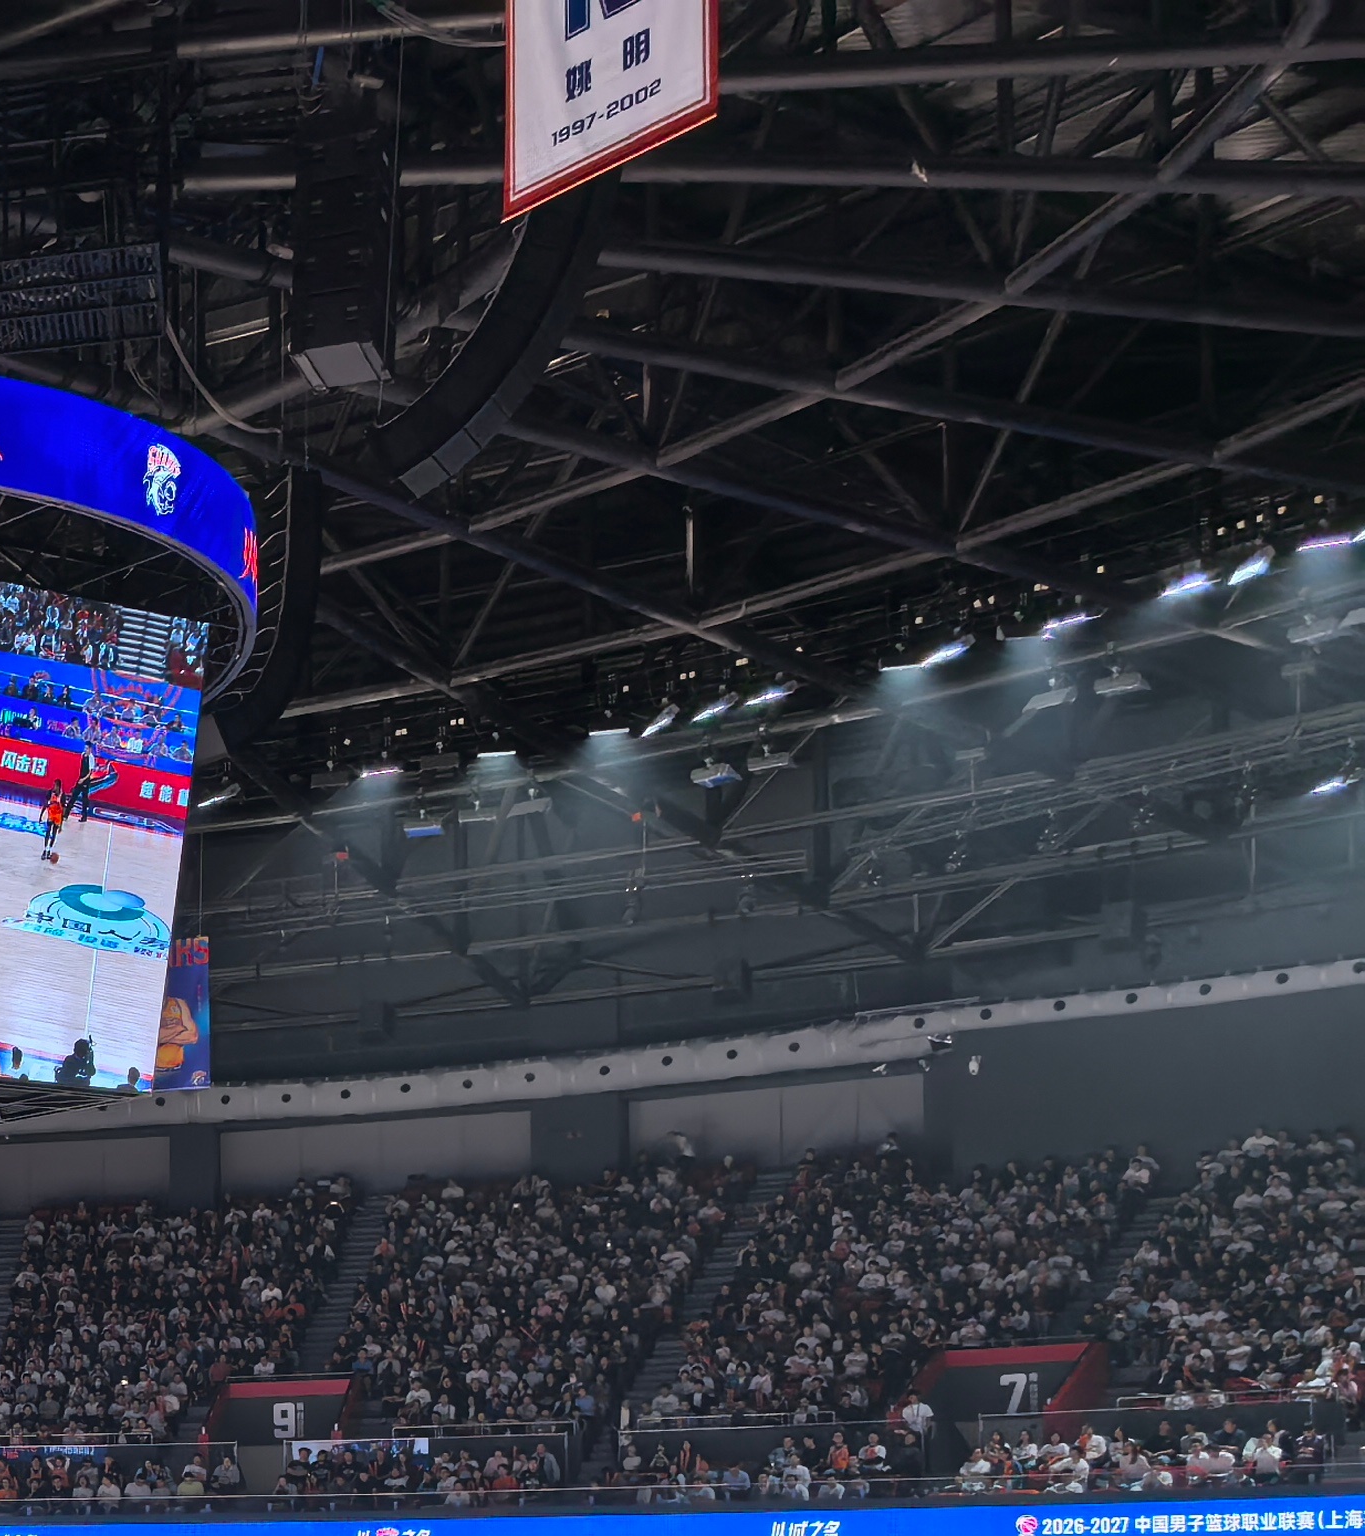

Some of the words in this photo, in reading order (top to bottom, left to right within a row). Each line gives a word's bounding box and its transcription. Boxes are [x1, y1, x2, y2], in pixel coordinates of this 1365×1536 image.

[565, 28, 650, 102] 姚明
[551, 78, 662, 147] 1997-2002
[0, 749, 49, 777] 闪击13
[139, 780, 191, 808] 超能
[1000, 1373, 1027, 1414] 7
[273, 1402, 296, 1439] 9
[1133, 1508, 1365, 1535] 中国男子篮球职业联赛(上海
